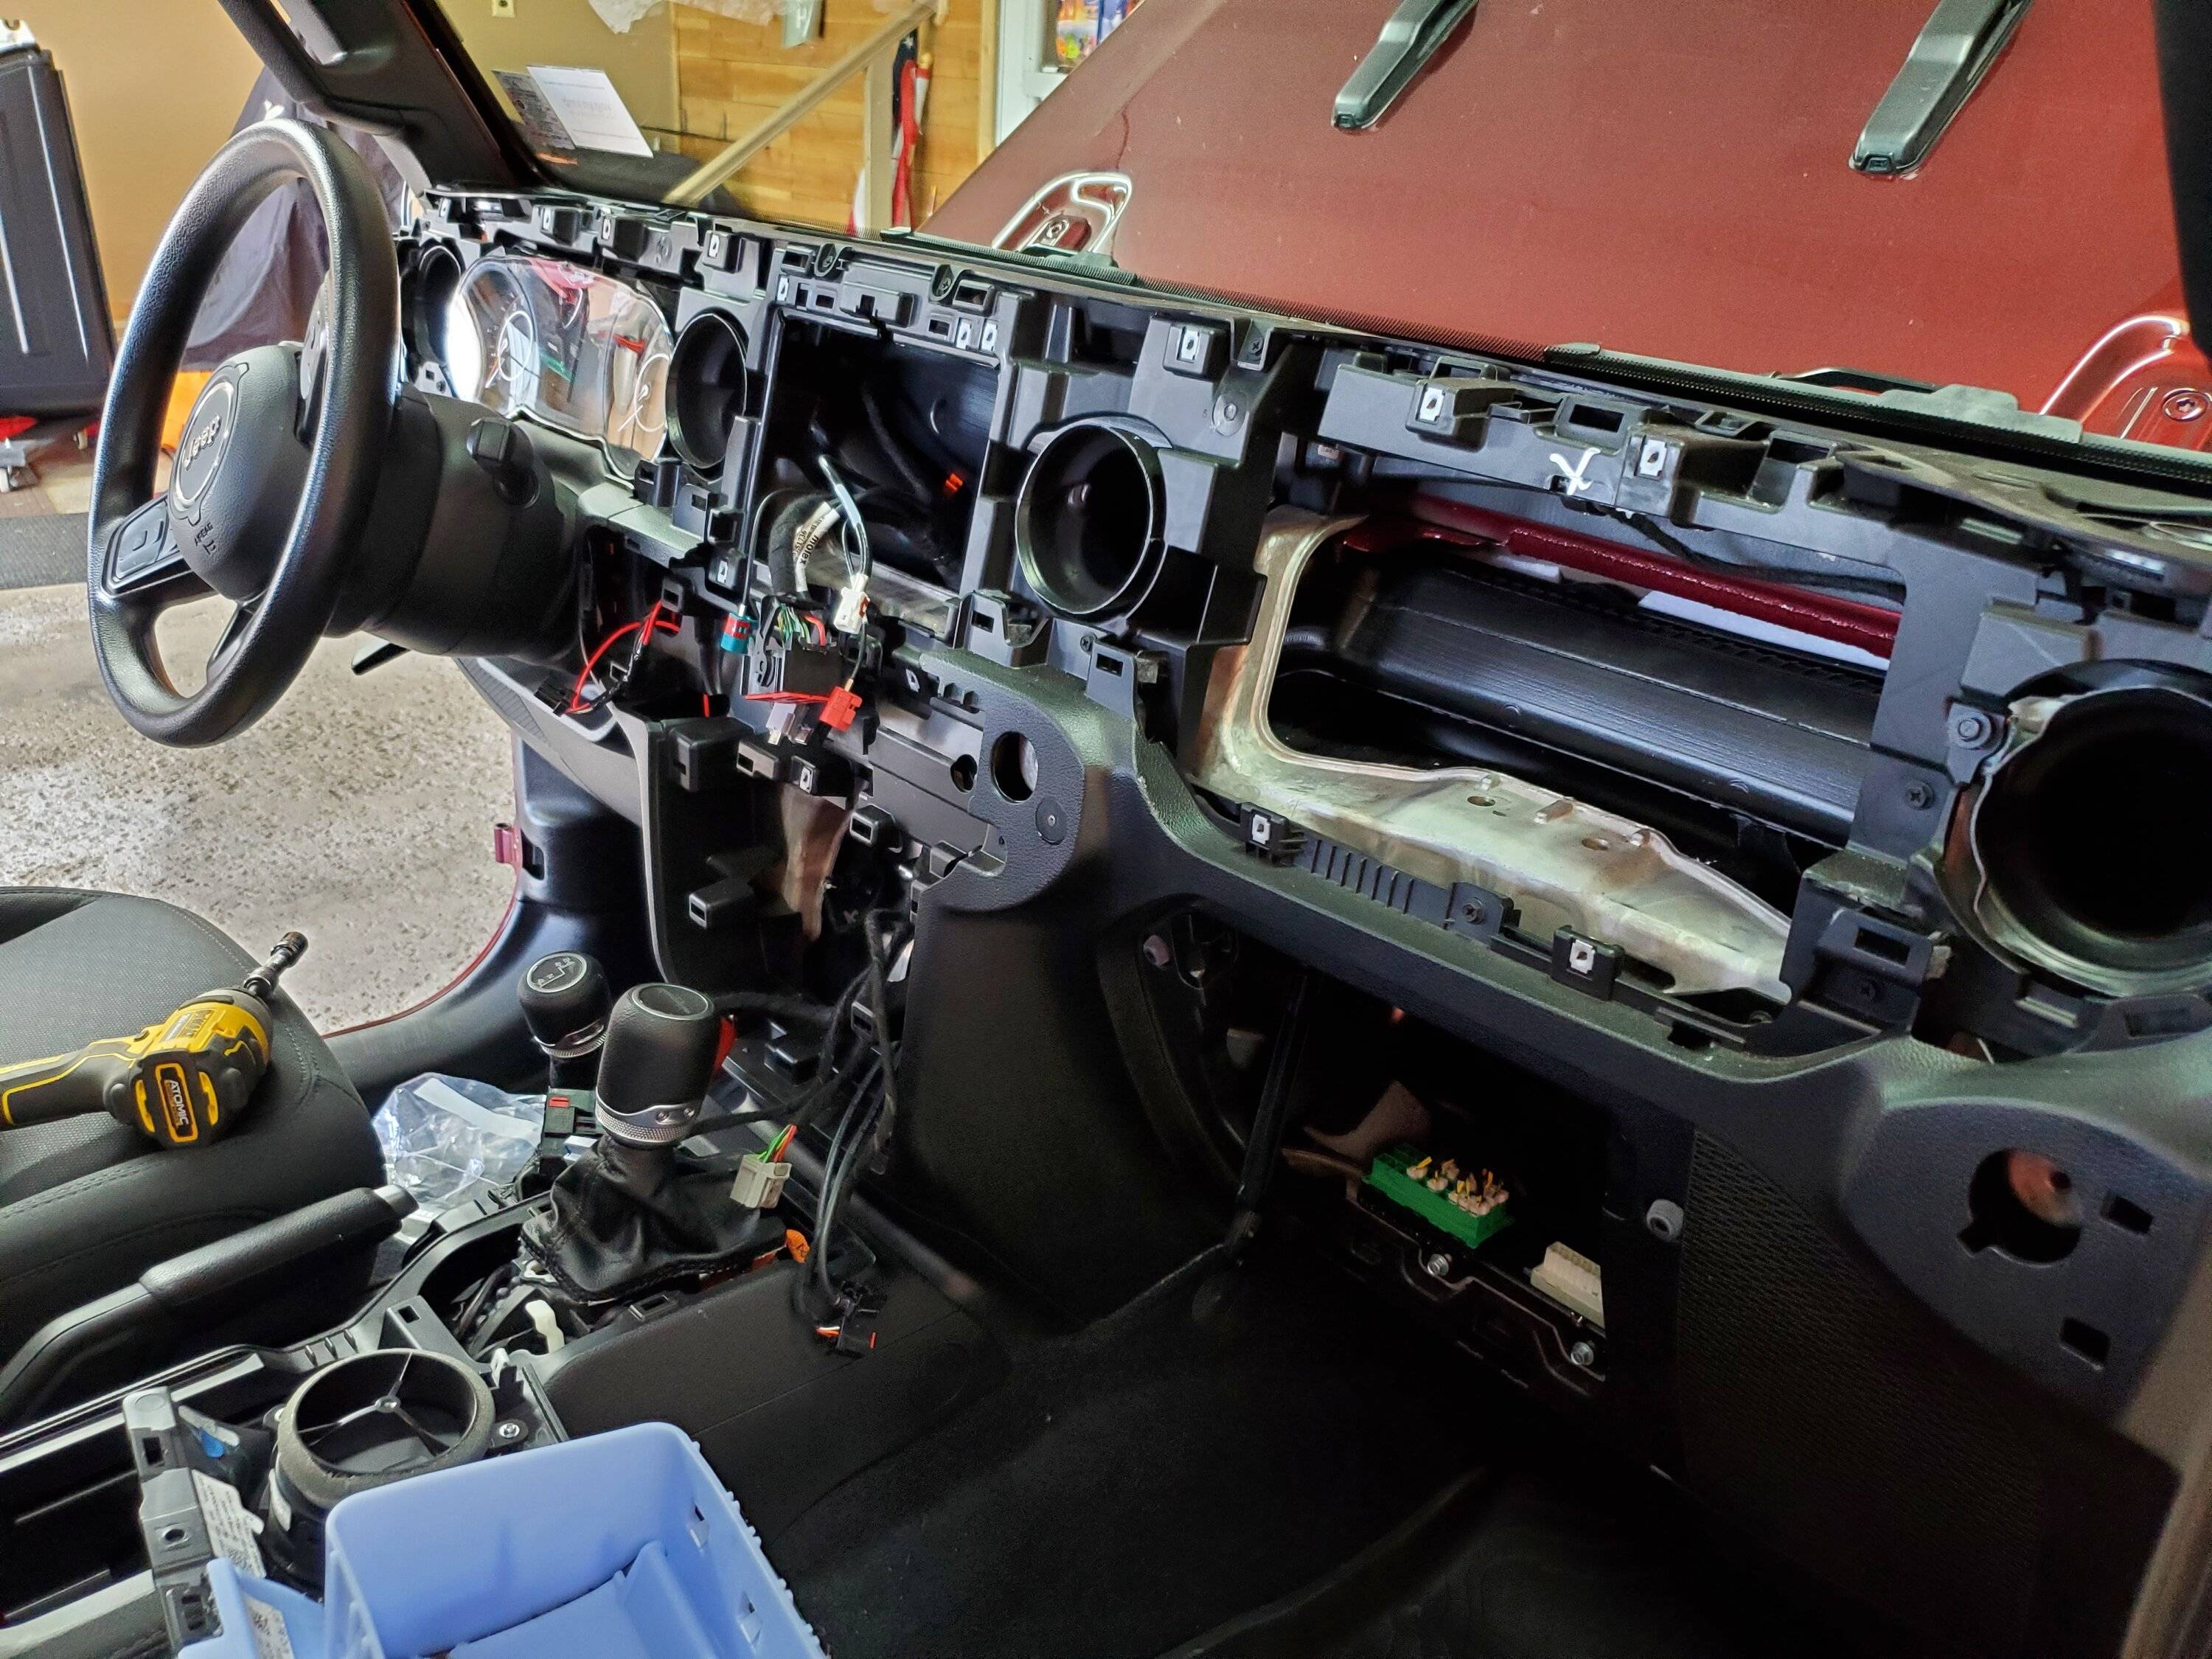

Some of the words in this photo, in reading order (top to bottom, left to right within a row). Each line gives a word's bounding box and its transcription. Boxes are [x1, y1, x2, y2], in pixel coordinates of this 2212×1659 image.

[182, 414, 221, 469] Jeep
[799, 535, 819, 566] molex
[170, 1080, 189, 1125] ATOMIC
